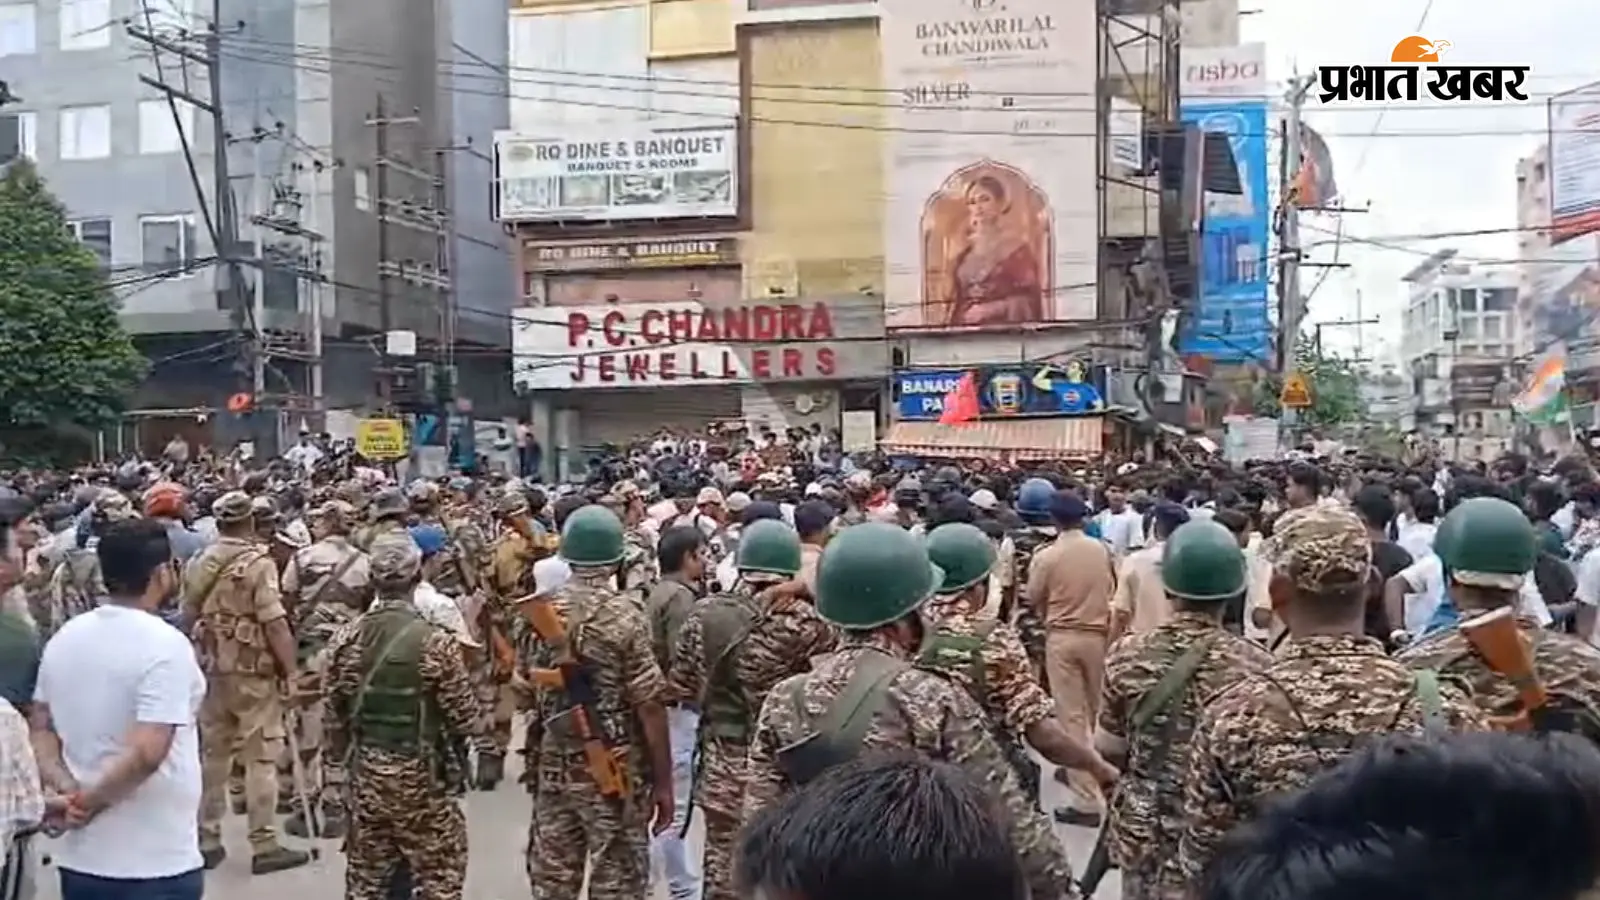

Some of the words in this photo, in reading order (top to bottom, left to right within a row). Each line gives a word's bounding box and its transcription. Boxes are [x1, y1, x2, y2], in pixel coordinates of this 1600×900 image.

[916, 15, 1056, 40] BANWARILAL
[922, 37, 1049, 57] CHANDIWALA
[903, 83, 970, 105] SILVER
[567, 142, 610, 159] DINE
[635, 137, 724, 156] BANQUET
[567, 161, 631, 172] BANQUET
[570, 350, 837, 383] JEWELLERS
